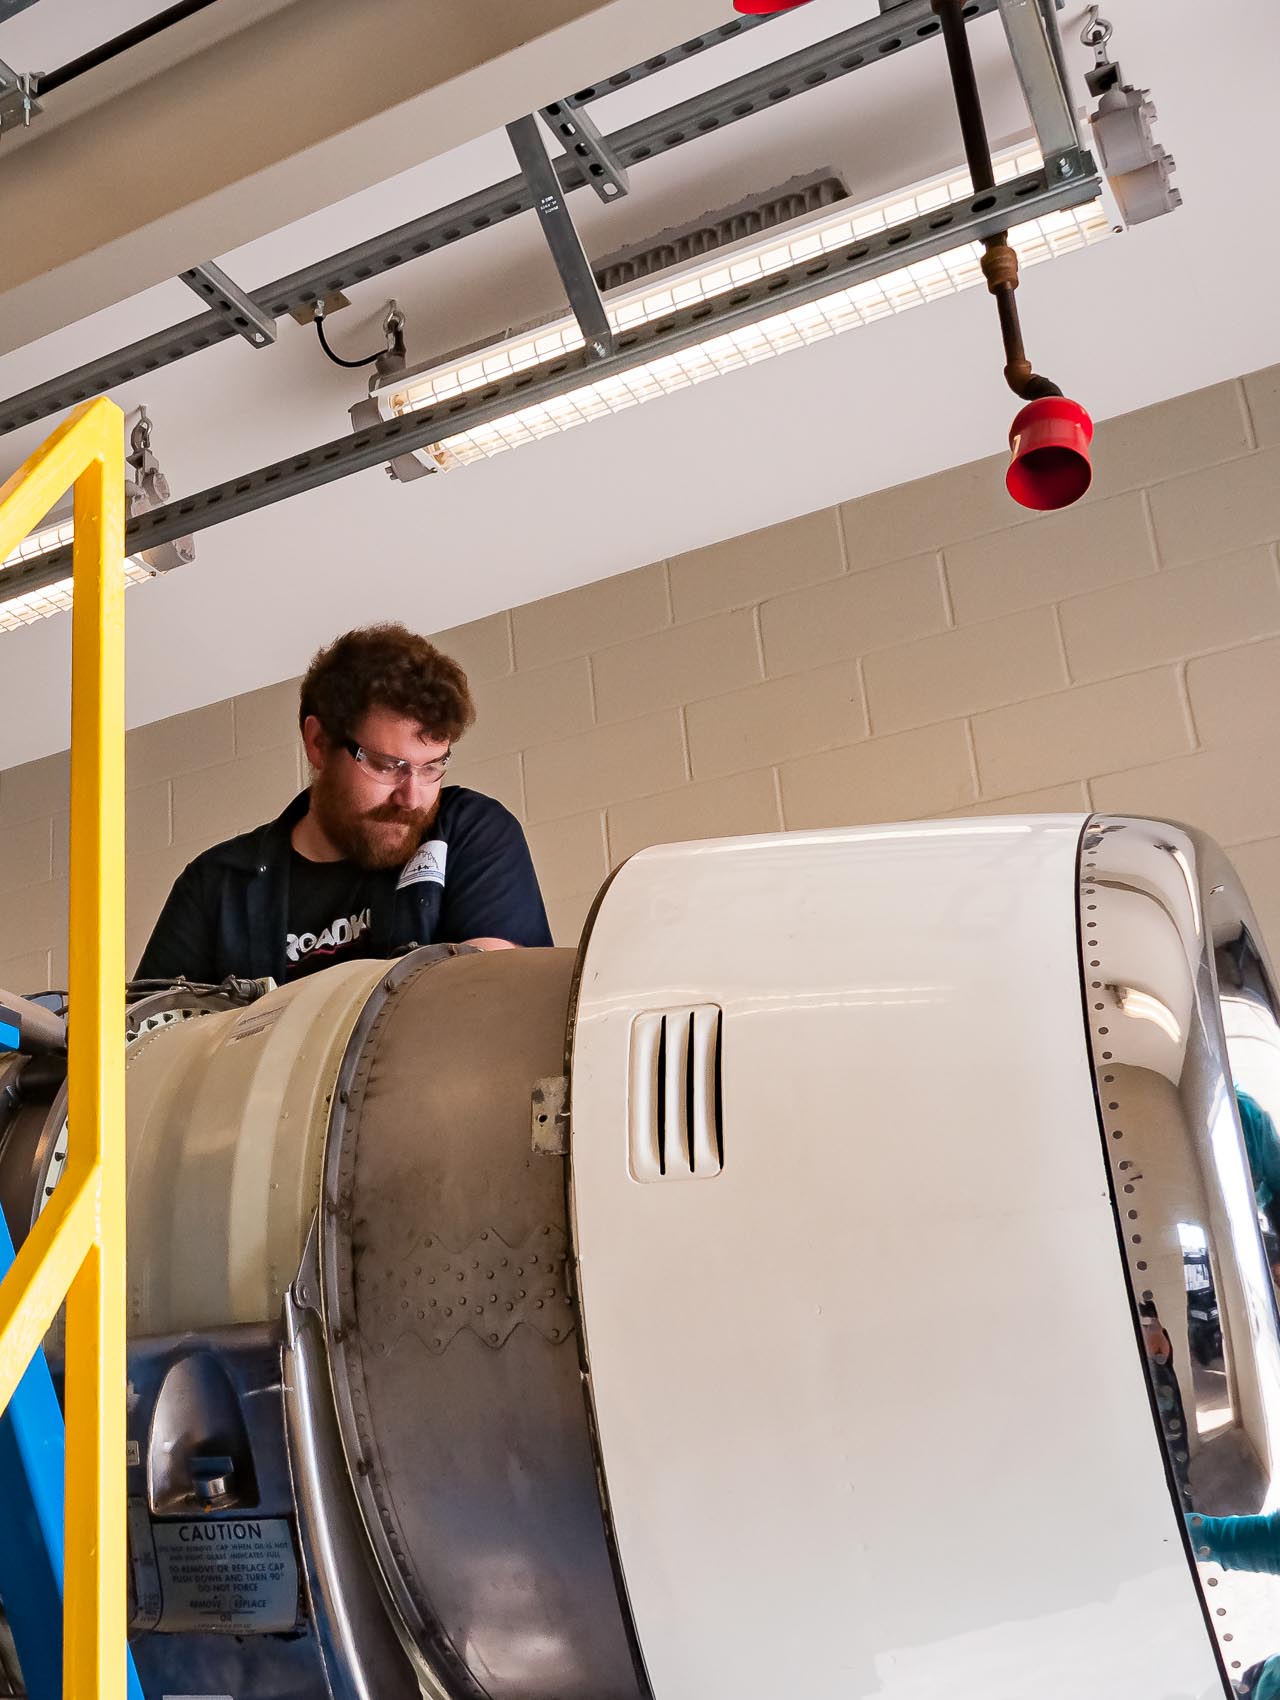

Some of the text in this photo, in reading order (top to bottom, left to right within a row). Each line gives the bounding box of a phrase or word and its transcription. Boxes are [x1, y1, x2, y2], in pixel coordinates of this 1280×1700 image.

[178, 1522, 262, 1542] CAUTION
[231, 1542, 252, 1550] WHEN
[231, 1563, 266, 1572] REPLACE
[268, 1562, 285, 1572] CAP
[225, 1573, 244, 1582] AND
[246, 1572, 267, 1581] TURN
[232, 1582, 259, 1592] FORCE
